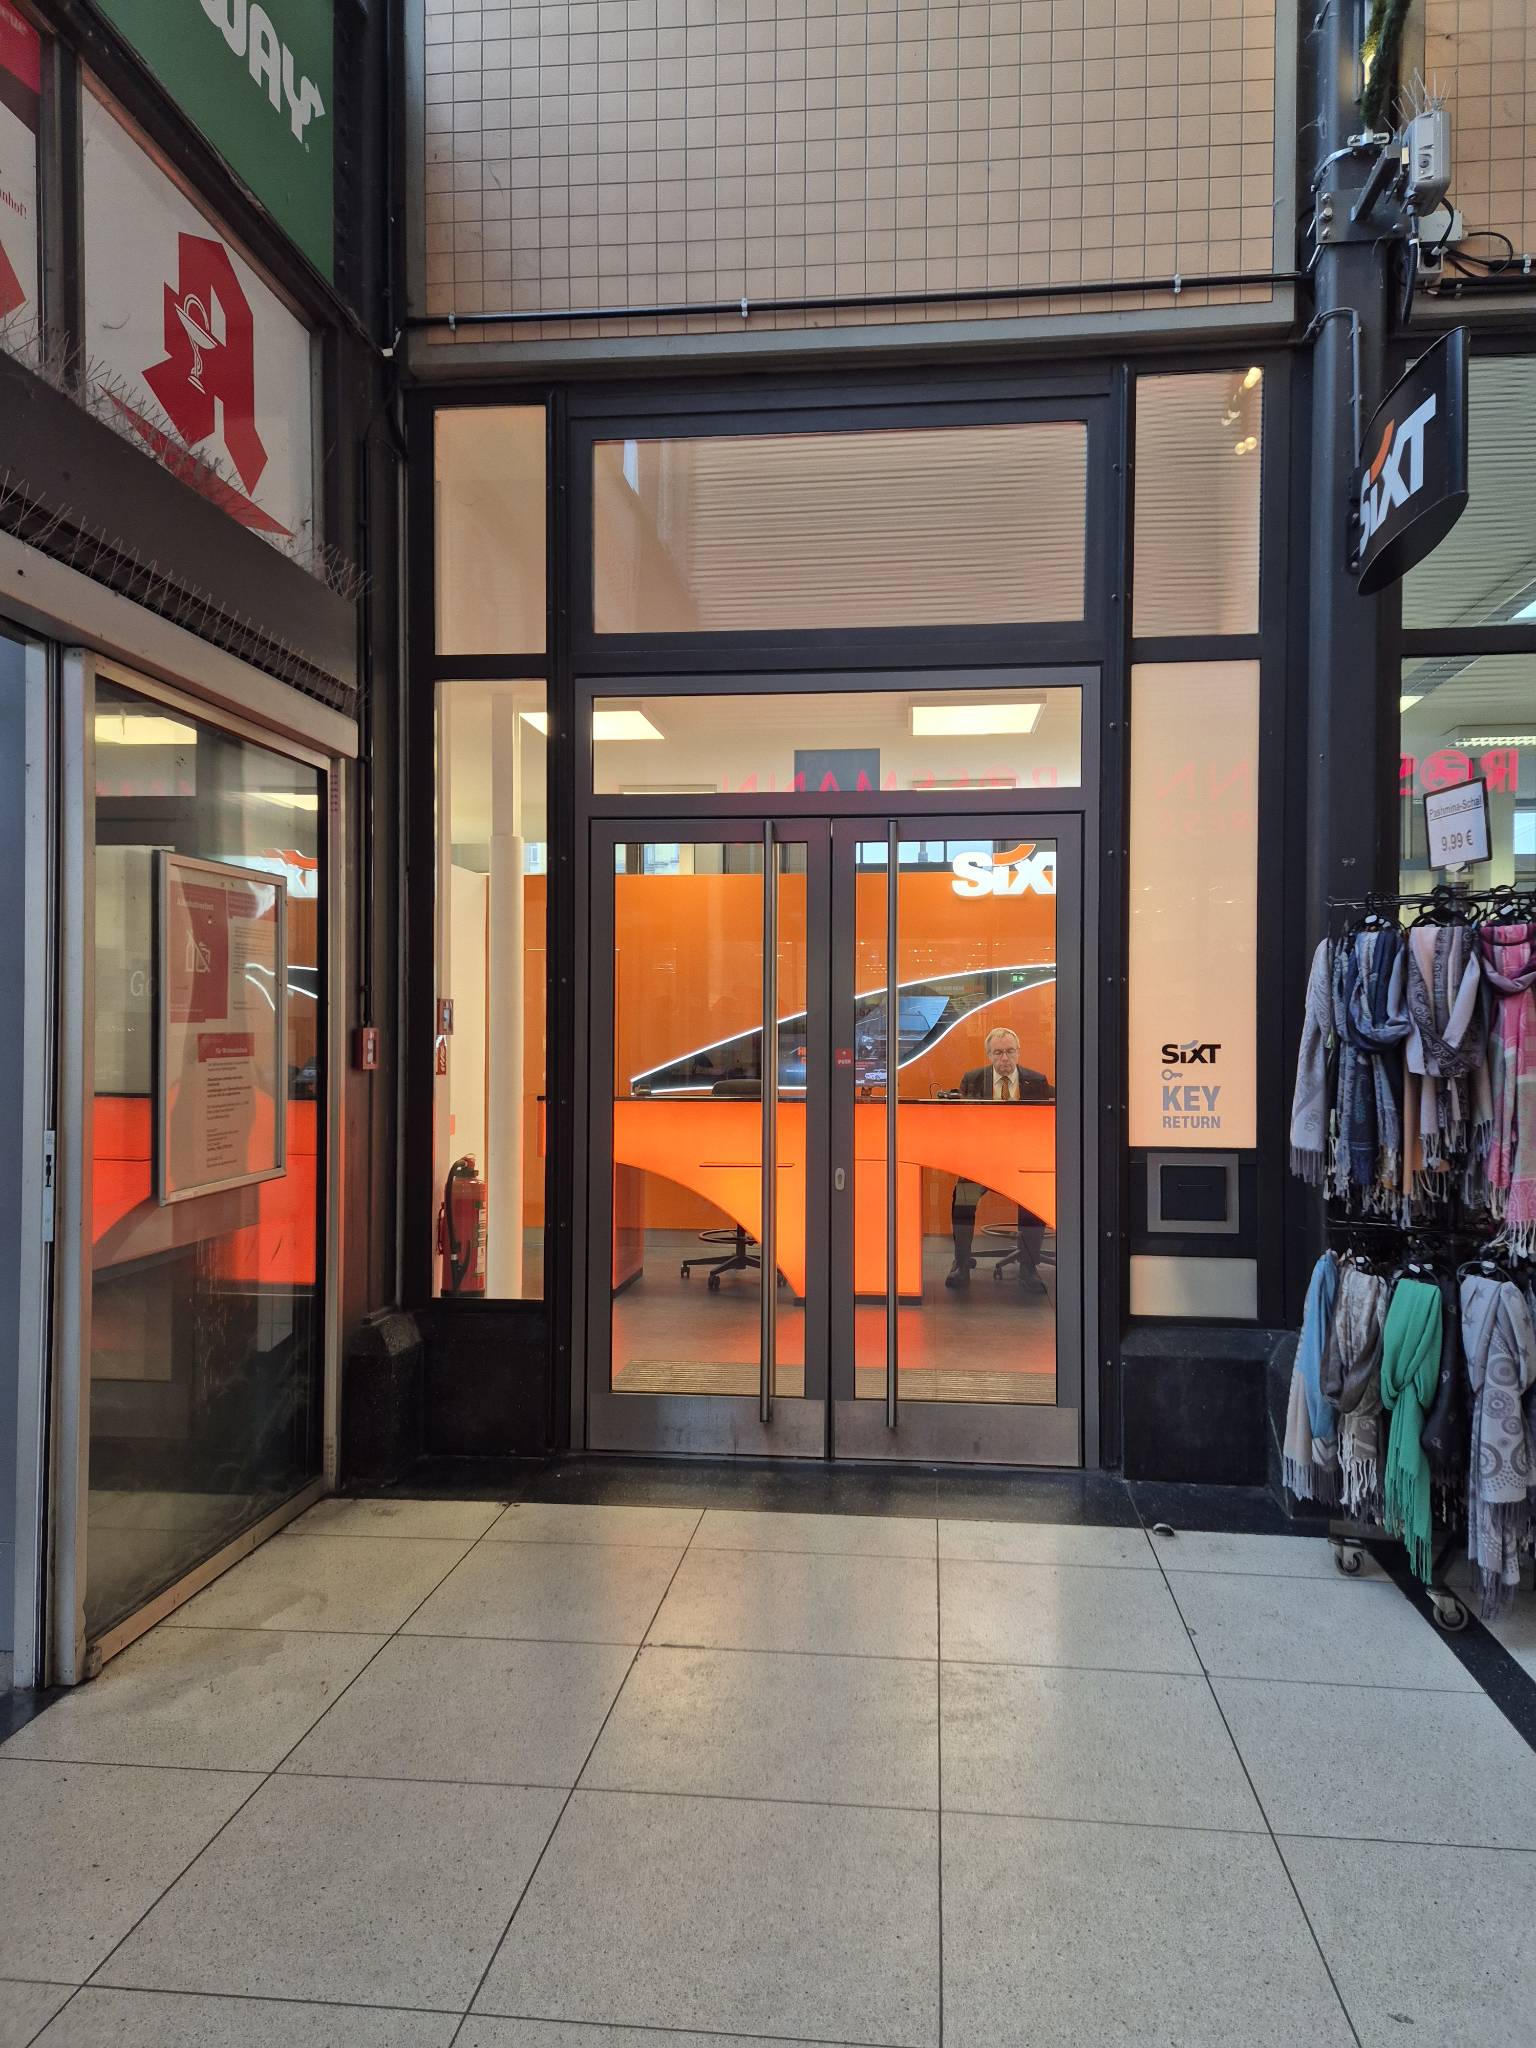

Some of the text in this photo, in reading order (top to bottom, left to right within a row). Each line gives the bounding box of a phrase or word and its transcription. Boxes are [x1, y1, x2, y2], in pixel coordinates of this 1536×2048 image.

[1429, 795, 1483, 818] Pashmina-Schal
[1440, 830, 1474, 852] 9,99 €
[1162, 1086, 1221, 1112] KEY
[1162, 1116, 1221, 1129] RETURN
